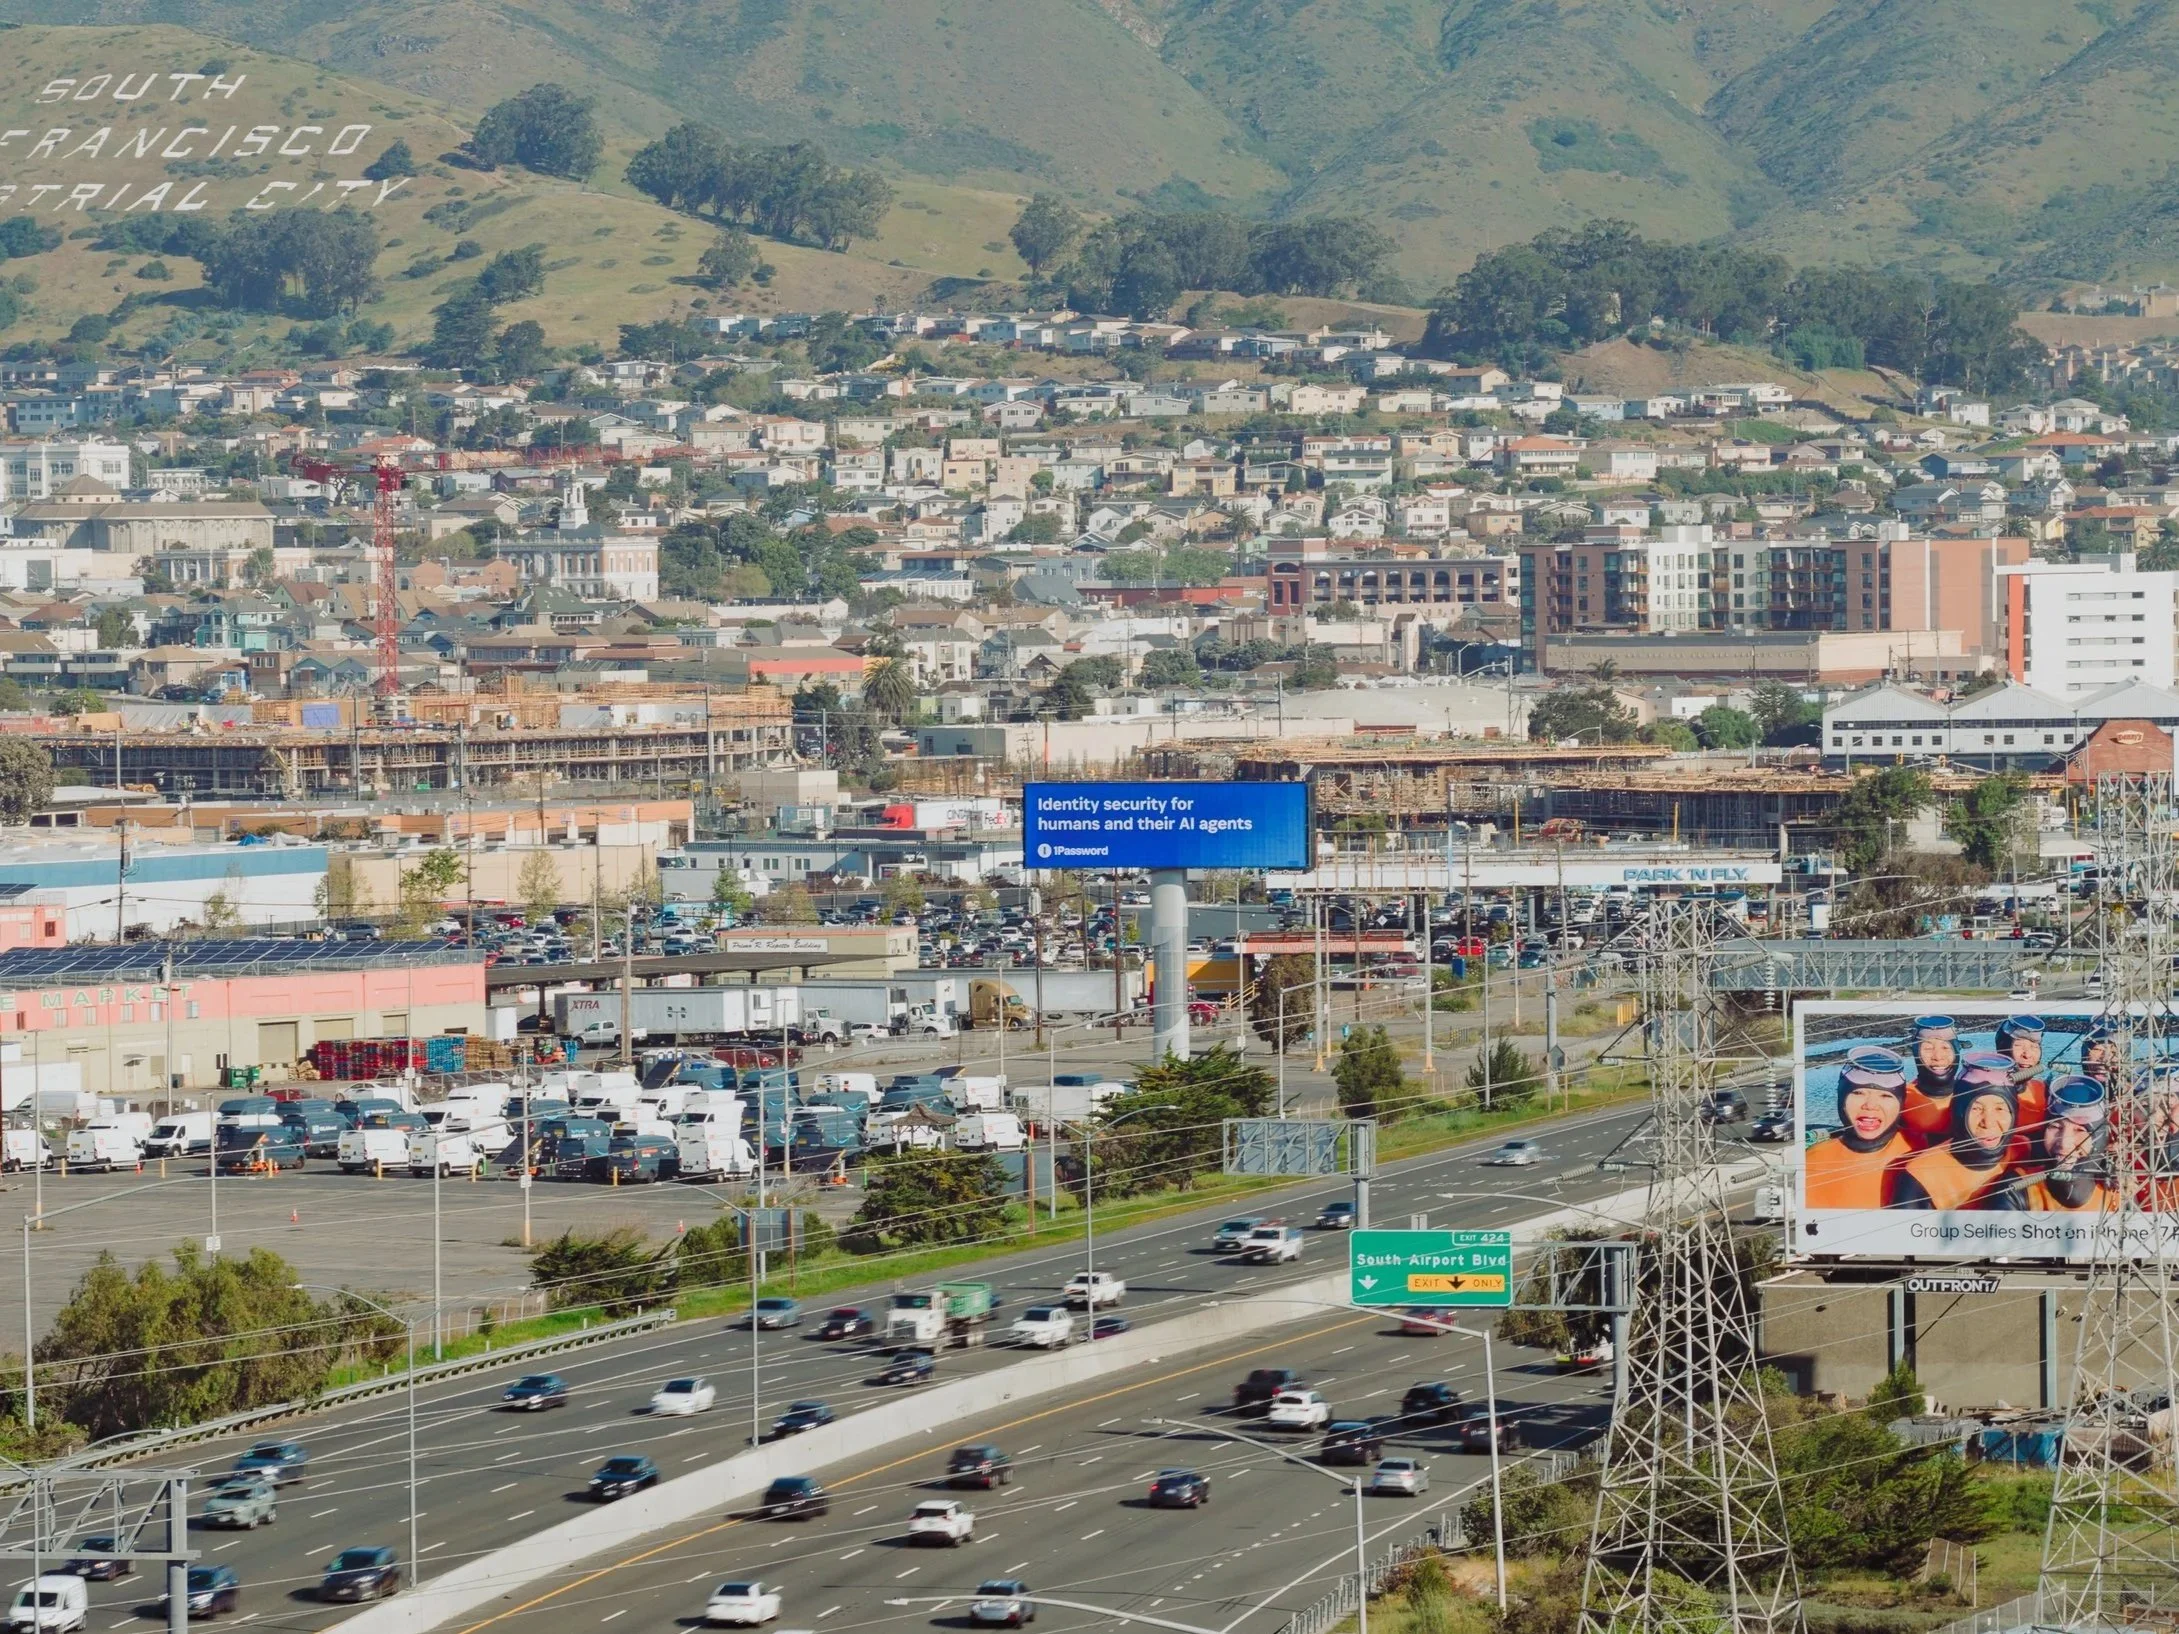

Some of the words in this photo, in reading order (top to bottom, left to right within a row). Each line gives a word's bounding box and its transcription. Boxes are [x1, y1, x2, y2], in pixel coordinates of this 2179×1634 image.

[35, 72, 247, 105] SOUTH
[245, 177, 412, 210] CITY
[1037, 796, 1099, 814] Identity
[1103, 797, 1166, 814] security
[1171, 796, 1194, 811] for
[1037, 816, 1101, 831] humans
[1104, 816, 1134, 831] and
[1137, 816, 1176, 831] their
[1179, 817, 1195, 831] AI
[1199, 817, 1253, 834] agents
[1053, 845, 1109, 857] 1Password
[1623, 868, 1684, 881] PARK
[1687, 868, 1708, 881] 'N
[793, 940, 821, 950] Building
[42, 983, 193, 1010] MARKET
[570, 1000, 600, 1012] XTRA
[1480, 1233, 1505, 1243] 424
[1910, 1222, 1959, 1242] Group
[1963, 1222, 2017, 1240] Selfies
[2021, 1222, 2060, 1240] Shot
[2065, 1228, 2086, 1240] on
[1357, 1253, 1401, 1266] South
[1409, 1253, 1465, 1269] Airport
[1472, 1253, 1506, 1266] Blvd
[1414, 1278, 1440, 1288] EXIT
[1473, 1278, 1502, 1288] ONLY
